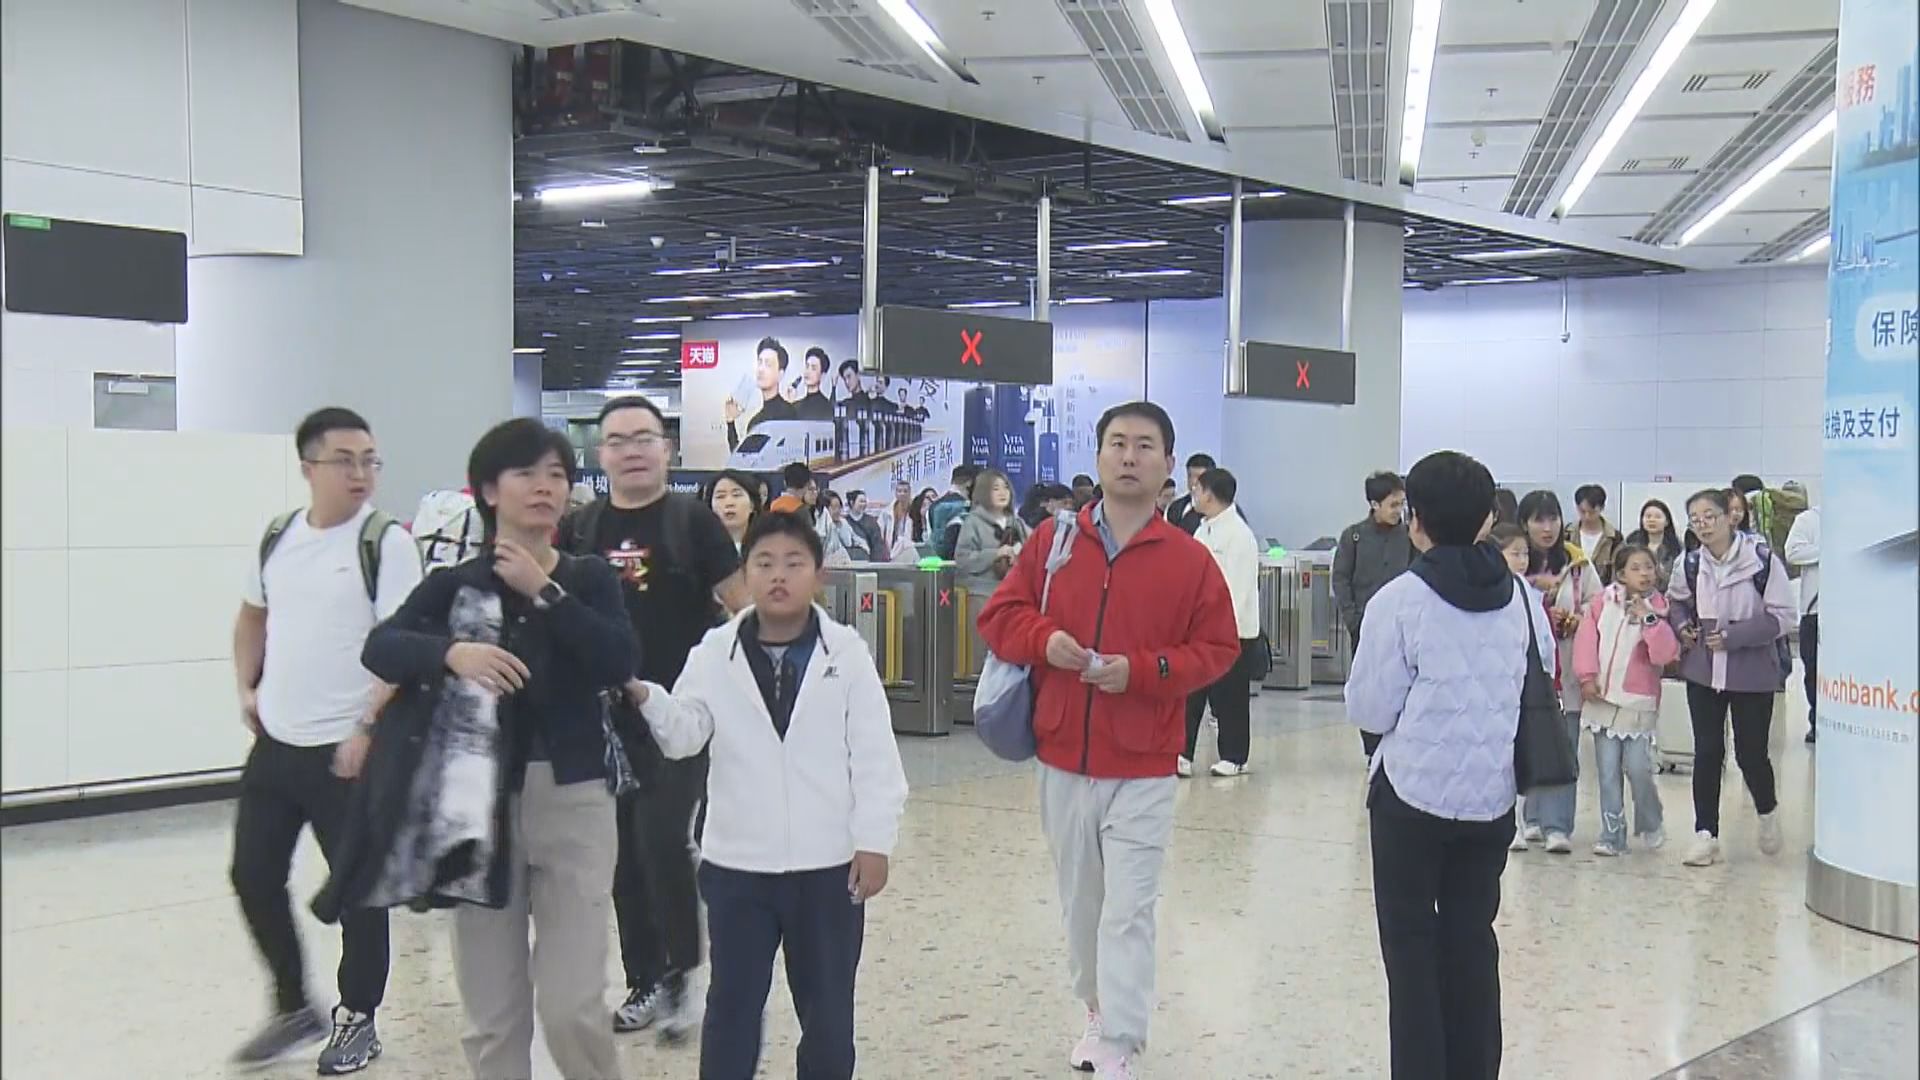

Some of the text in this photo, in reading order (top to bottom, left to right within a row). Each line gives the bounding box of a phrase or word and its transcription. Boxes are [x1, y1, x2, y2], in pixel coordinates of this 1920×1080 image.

[971, 435, 988, 446] VITA
[1003, 432, 1024, 444] VITA
[1004, 444, 1025, 456] HAIR
